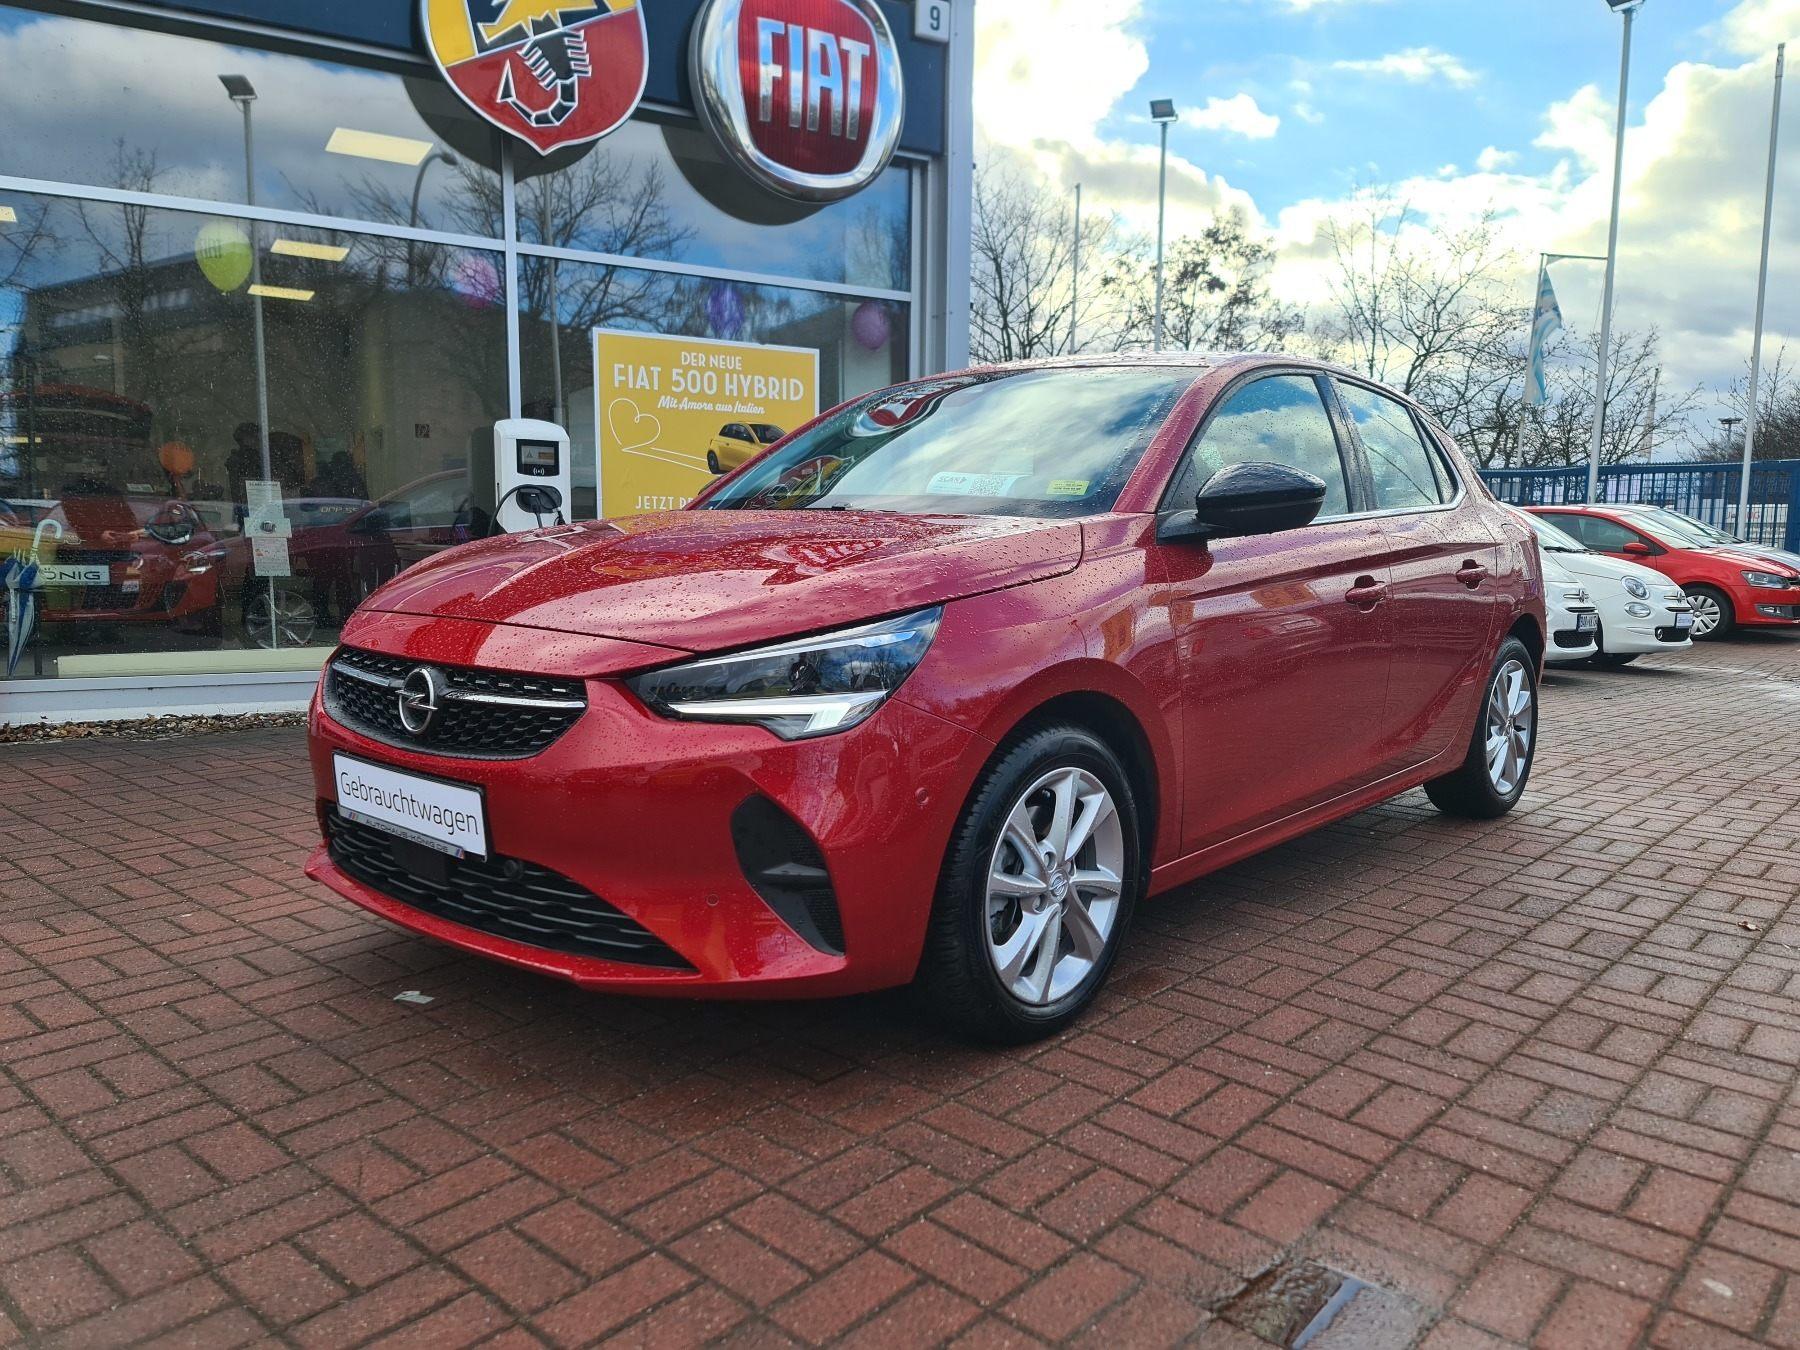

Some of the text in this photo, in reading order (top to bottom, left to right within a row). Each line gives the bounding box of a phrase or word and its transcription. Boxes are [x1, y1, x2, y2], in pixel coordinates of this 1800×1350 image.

[929, 5, 941, 31] 9
[756, 16, 870, 141] FIAT
[681, 351, 742, 371] DER NEUE
[613, 363, 805, 401] FIAT 500 HYBRID
[657, 395, 765, 415] Mit Amore aus Italien
[635, 495, 675, 510] JETZT
[42, 567, 101, 581] ÖNIG
[340, 771, 479, 835] Gebrauchtwagen
